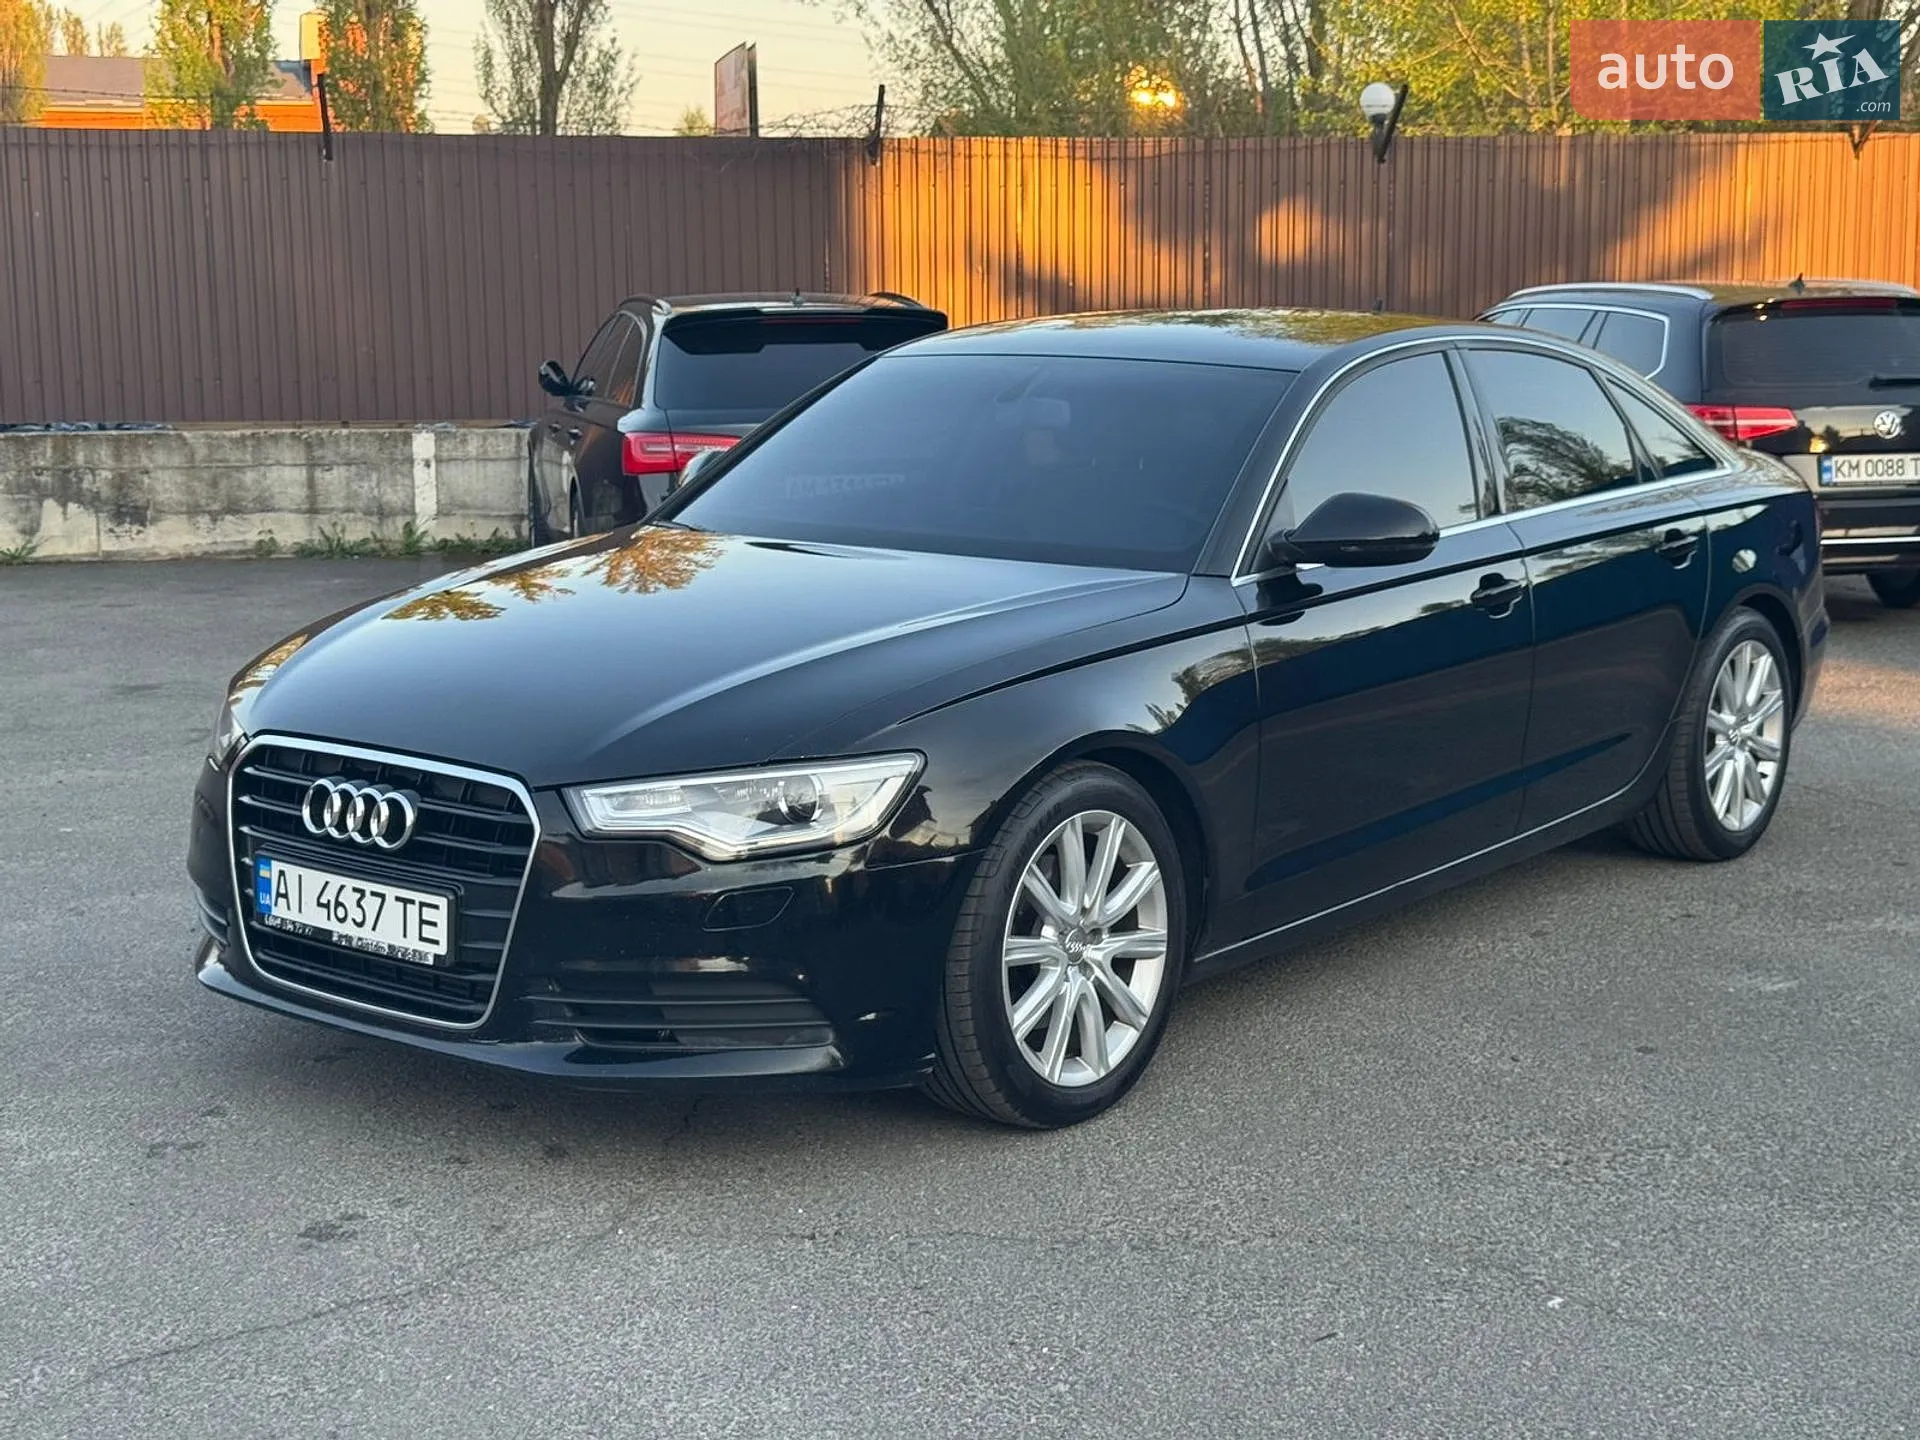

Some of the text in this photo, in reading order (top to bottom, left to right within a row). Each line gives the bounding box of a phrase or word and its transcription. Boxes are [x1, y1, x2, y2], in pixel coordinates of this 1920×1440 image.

[1834, 459, 1861, 479] KM
[1864, 458, 1906, 478] 0088
[259, 892, 272, 906] UA
[274, 869, 303, 914] AI
[316, 880, 387, 933] 4637
[394, 895, 440, 946] TE
